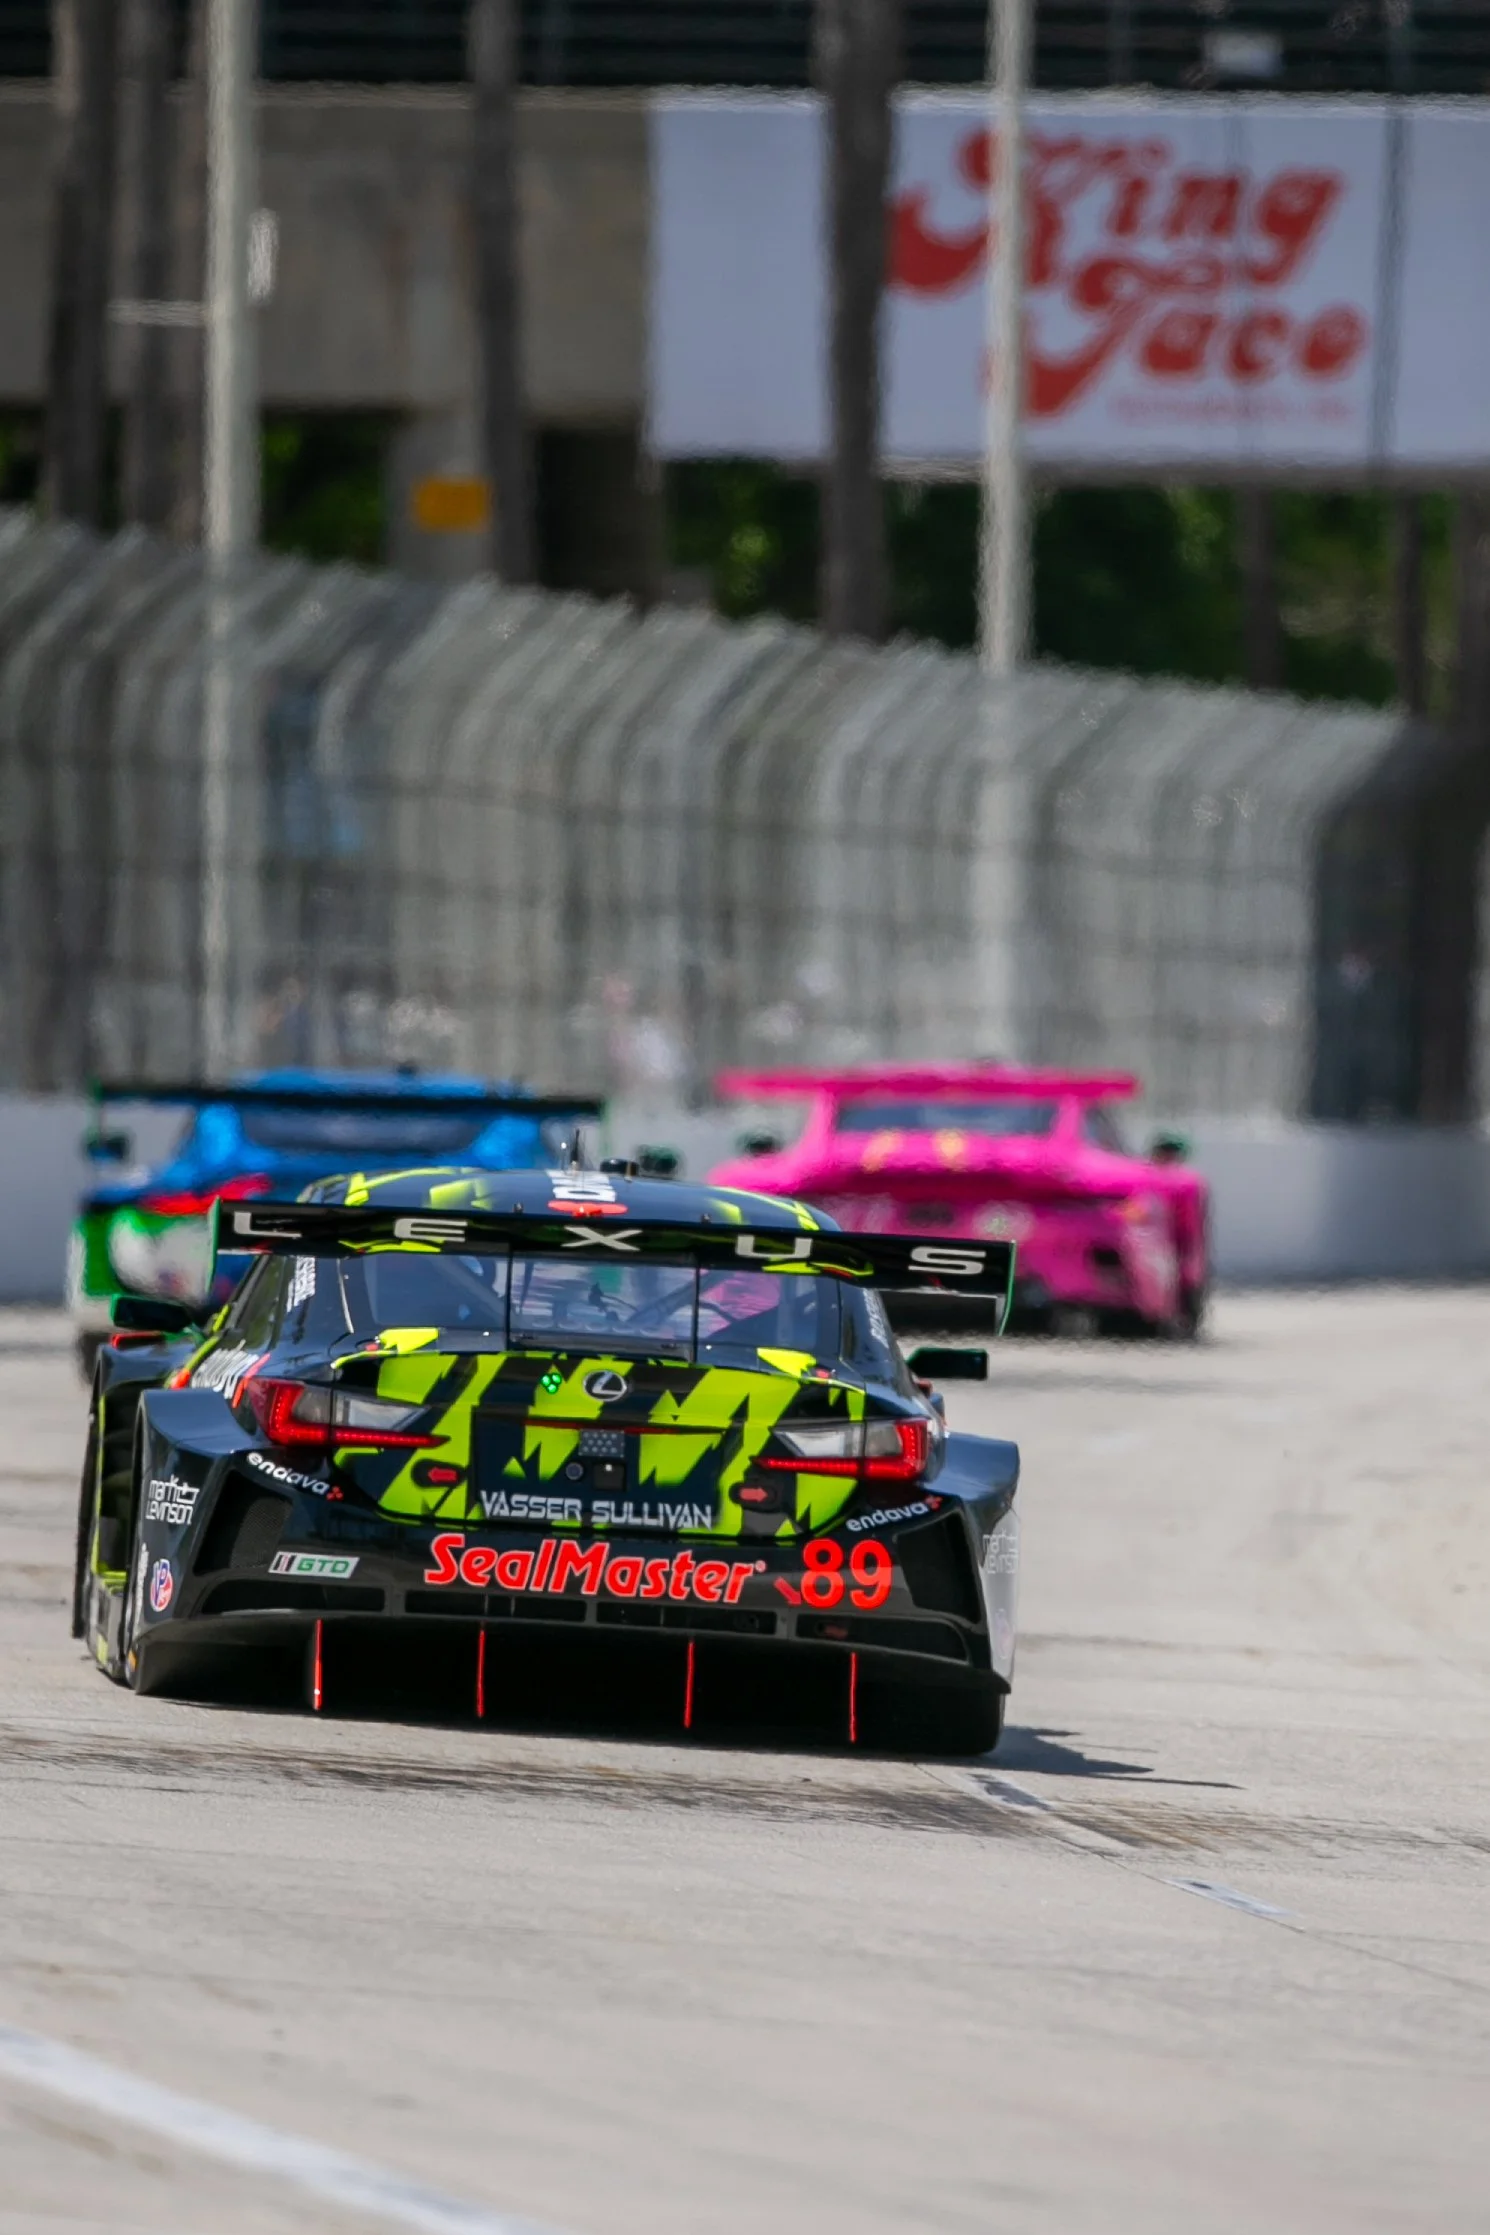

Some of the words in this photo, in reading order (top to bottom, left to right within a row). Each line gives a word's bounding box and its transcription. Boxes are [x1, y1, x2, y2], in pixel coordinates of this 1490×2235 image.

[884, 130, 1344, 298] King
[982, 254, 1367, 421] Taco
[233, 1211, 987, 1275] LEXUS
[246, 1451, 331, 1496] endava
[480, 1490, 582, 1521] VASSER
[591, 1500, 713, 1530] SULLIVAN
[845, 1501, 930, 1533] endava
[296, 1557, 351, 1574] GTD
[424, 1532, 755, 1603] SealMaster
[800, 1537, 894, 1610] 89
